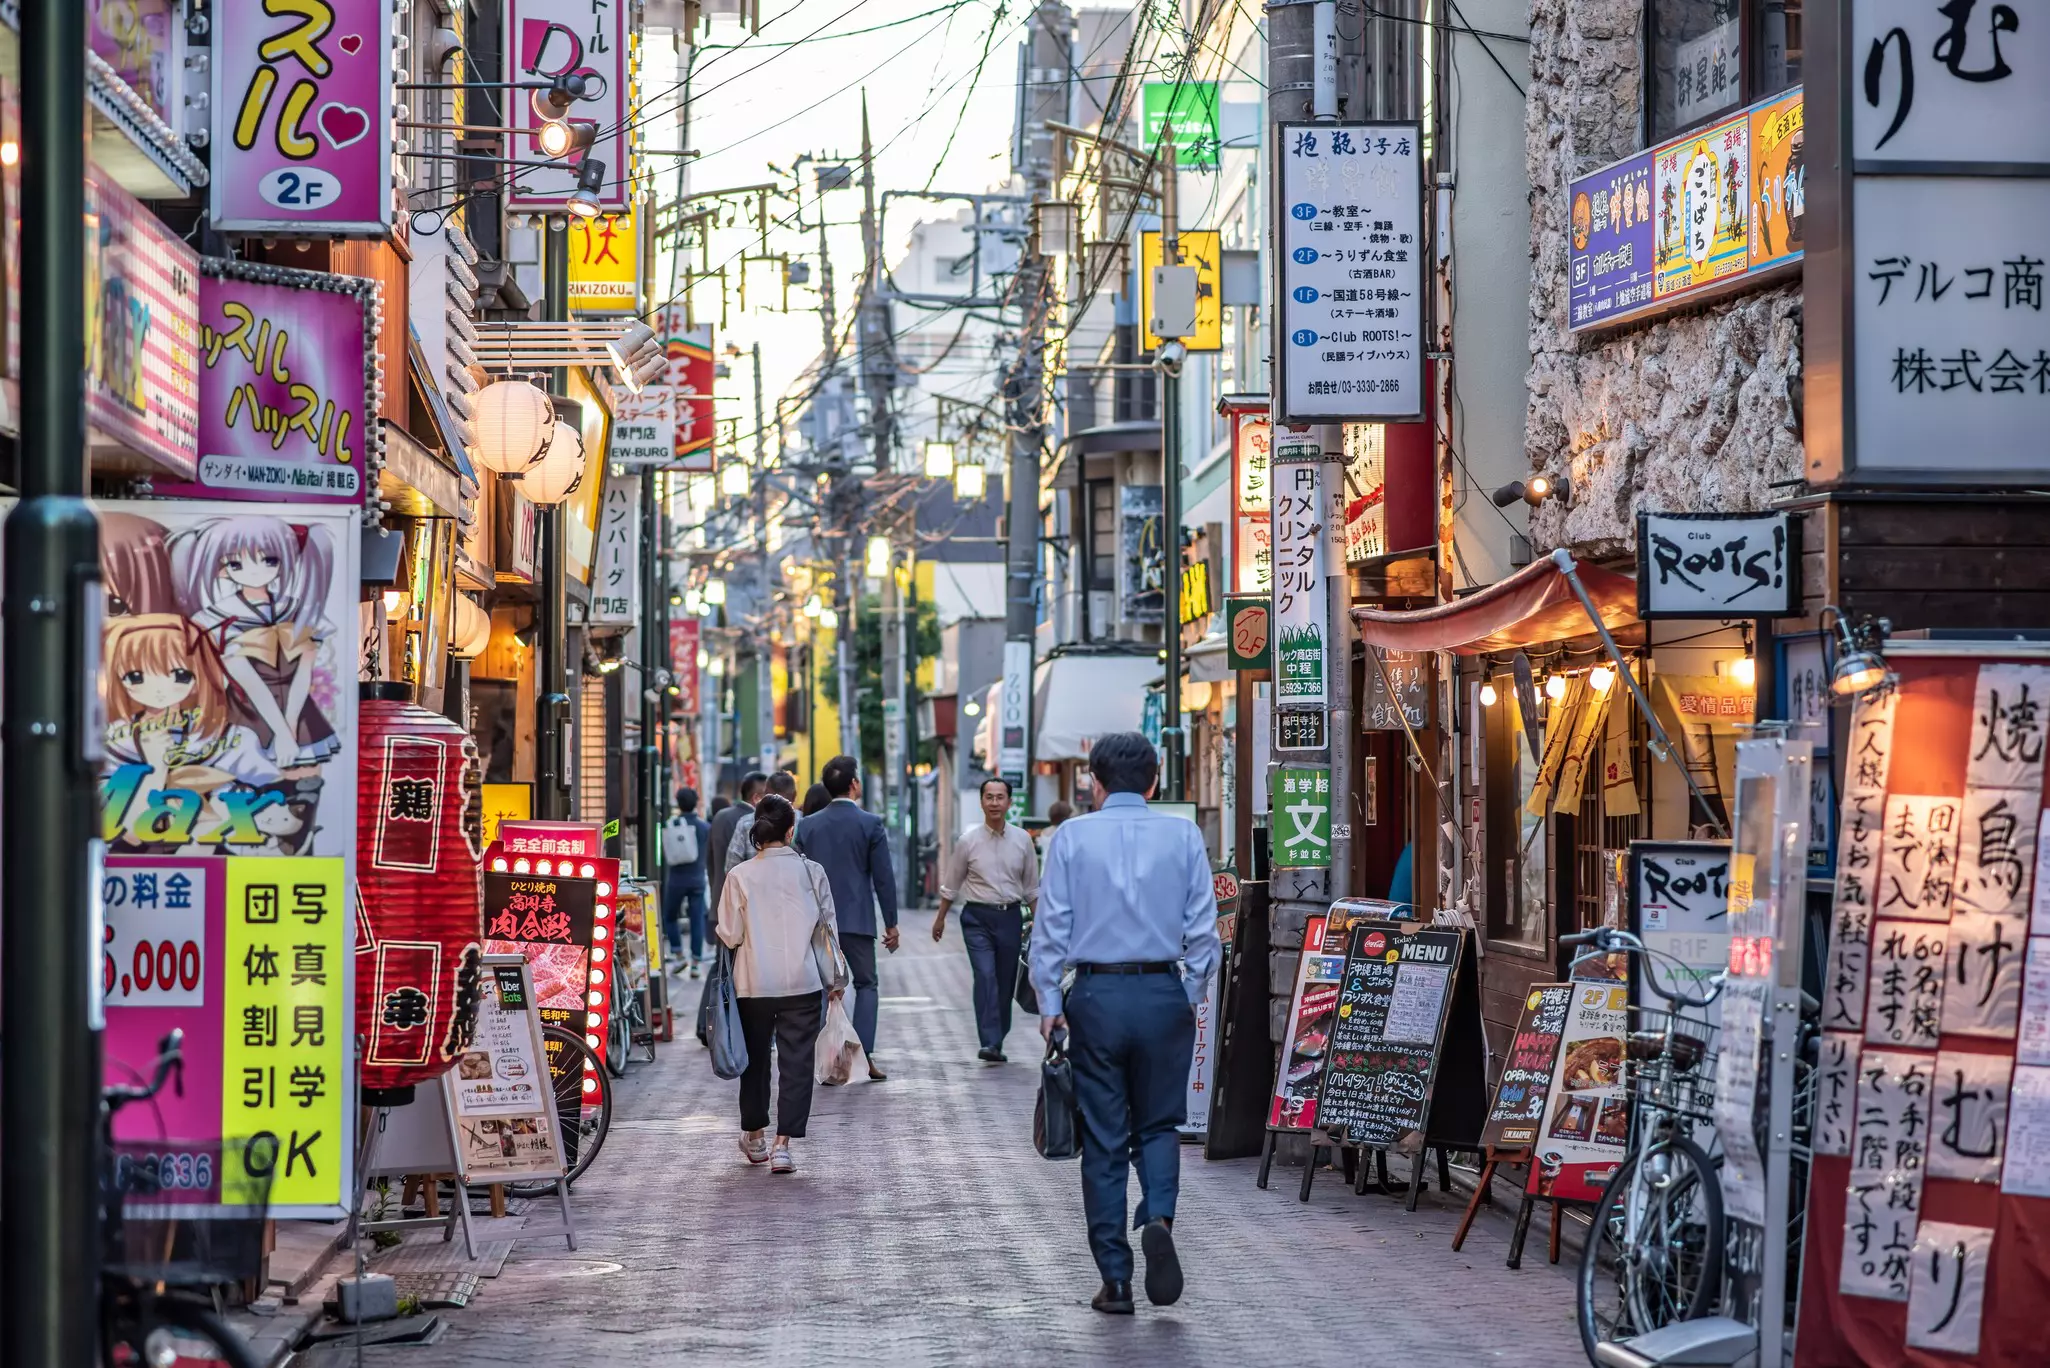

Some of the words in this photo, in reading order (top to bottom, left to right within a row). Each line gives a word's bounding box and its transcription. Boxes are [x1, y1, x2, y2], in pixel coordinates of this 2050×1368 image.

[1363, 137, 1411, 157] 3号店
[277, 172, 323, 205] 2F
[1296, 206, 1313, 218] 3F
[1694, 161, 1709, 251] ごっぱち
[1298, 250, 1314, 262] 2F
[1348, 269, 1396, 280] (古酒BAR)
[1575, 263, 1586, 281] 3F
[1867, 254, 2045, 312] デルコ商
[1298, 289, 1314, 301] 1F
[1330, 308, 1400, 319] (ステーキ酒場)
[1297, 333, 1313, 343] B1
[1321, 350, 1410, 362] (民謡ライブハウス)
[616, 409, 668, 422] ステーキ
[225, 383, 352, 464] ハッスル
[616, 426, 657, 440] 専門店
[611, 447, 669, 458] EW-BURG
[607, 488, 628, 587] ハンバーグ
[1295, 467, 1316, 593] 円メンタル
[1687, 531, 1712, 541] Club
[1278, 495, 1295, 615] クリニック
[1236, 628, 1267, 654] 2F
[1280, 648, 1321, 661] ルック商店街
[1286, 662, 1312, 675] 中程
[1282, 715, 1320, 727] 高円寺北
[1284, 728, 1317, 739] 3-22
[1283, 777, 1329, 793] 通学路
[1284, 798, 1328, 847] 文
[511, 837, 586, 855] 完全前金制
[1288, 848, 1322, 860] 杉並区
[1674, 857, 1696, 866] Club
[510, 881, 557, 895] ひとり焼肉
[509, 892, 557, 912] 高円寺
[488, 908, 573, 944] 肉合戦
[1392, 934, 1418, 945] Today's
[1669, 938, 1708, 956] B1F
[1401, 944, 1448, 961] MENU
[1349, 962, 1394, 976] 沖縄酒場
[500, 981, 520, 991] Uber
[1351, 977, 1363, 991] &
[242, 884, 280, 1109] 団体割引
[290, 884, 328, 1109] 写真見学
[502, 992, 522, 1003] Eats
[1342, 990, 1393, 1008] うりずん食堂
[1583, 989, 1604, 1005] 2F
[1928, 684, 2043, 1333] 焼鳥けむり
[1532, 1015, 1541, 1027] &
[1514, 1032, 1559, 1051] HAPPY
[242, 1130, 323, 1178] OK
